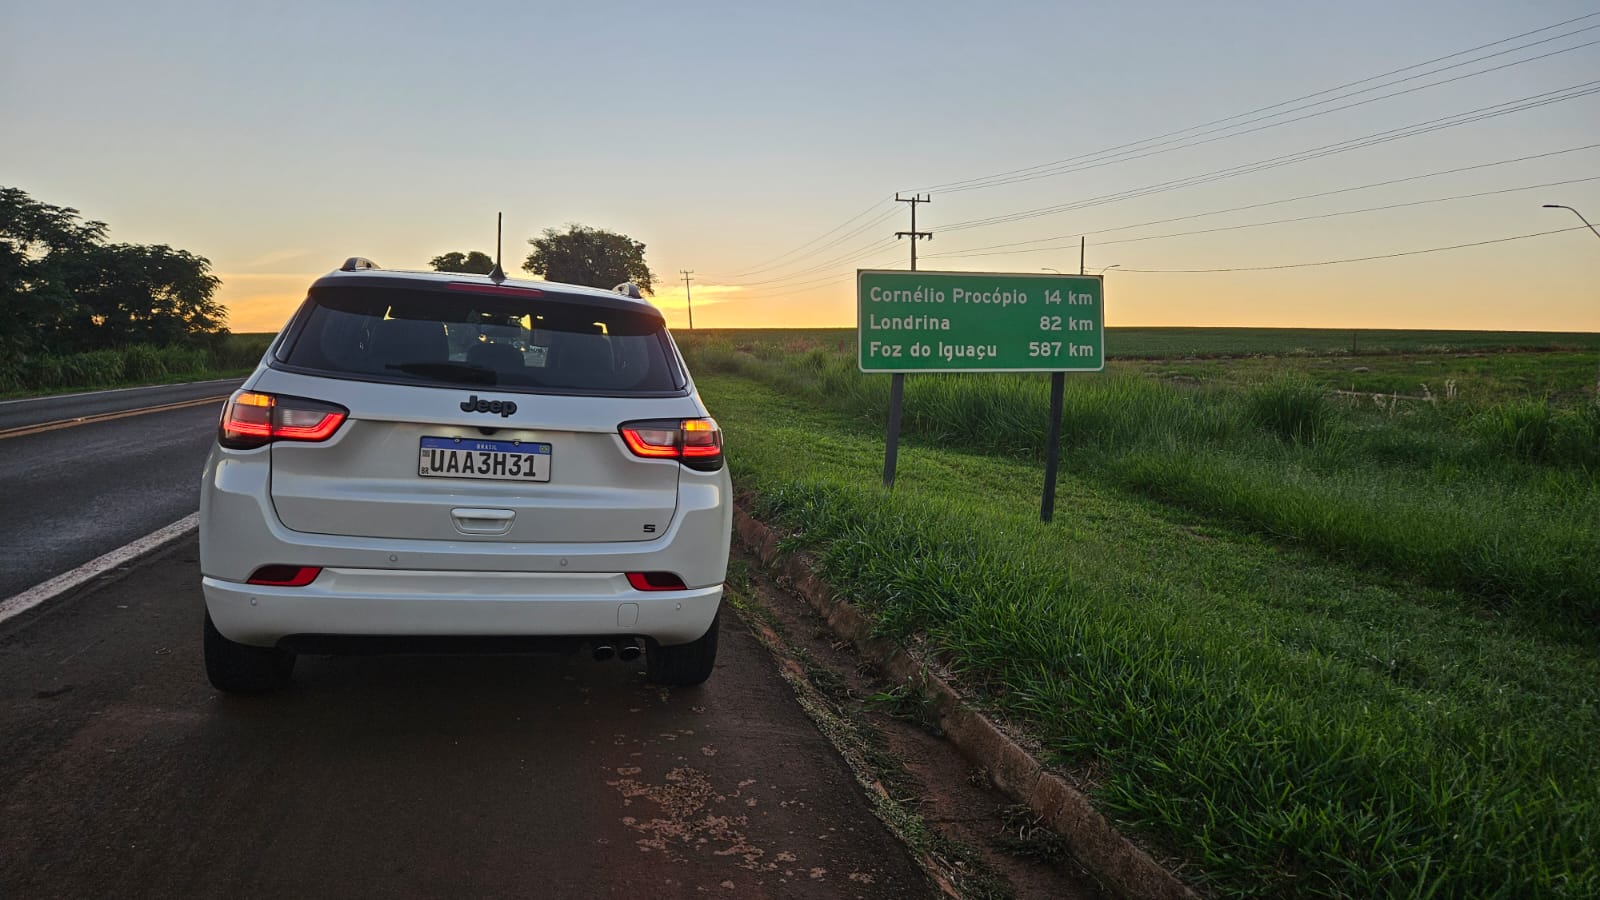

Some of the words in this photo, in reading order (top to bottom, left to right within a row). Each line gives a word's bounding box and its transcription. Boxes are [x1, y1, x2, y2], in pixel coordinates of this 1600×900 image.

[870, 285, 945, 303] Cornélio
[952, 287, 1028, 307] Procópio
[1044, 289, 1062, 305] 14
[1068, 290, 1093, 305] km
[870, 314, 950, 330] Londrina
[1039, 316, 1062, 331] 82
[1068, 316, 1093, 331] km
[869, 342, 902, 357] Foz
[910, 342, 931, 357] do
[938, 342, 997, 361] Iguaçu
[1028, 342, 1062, 357] 587
[1069, 342, 1094, 357] km
[460, 395, 517, 417] Jeep
[476, 443, 497, 451] BRASIL
[430, 449, 536, 477] UAA3H31
